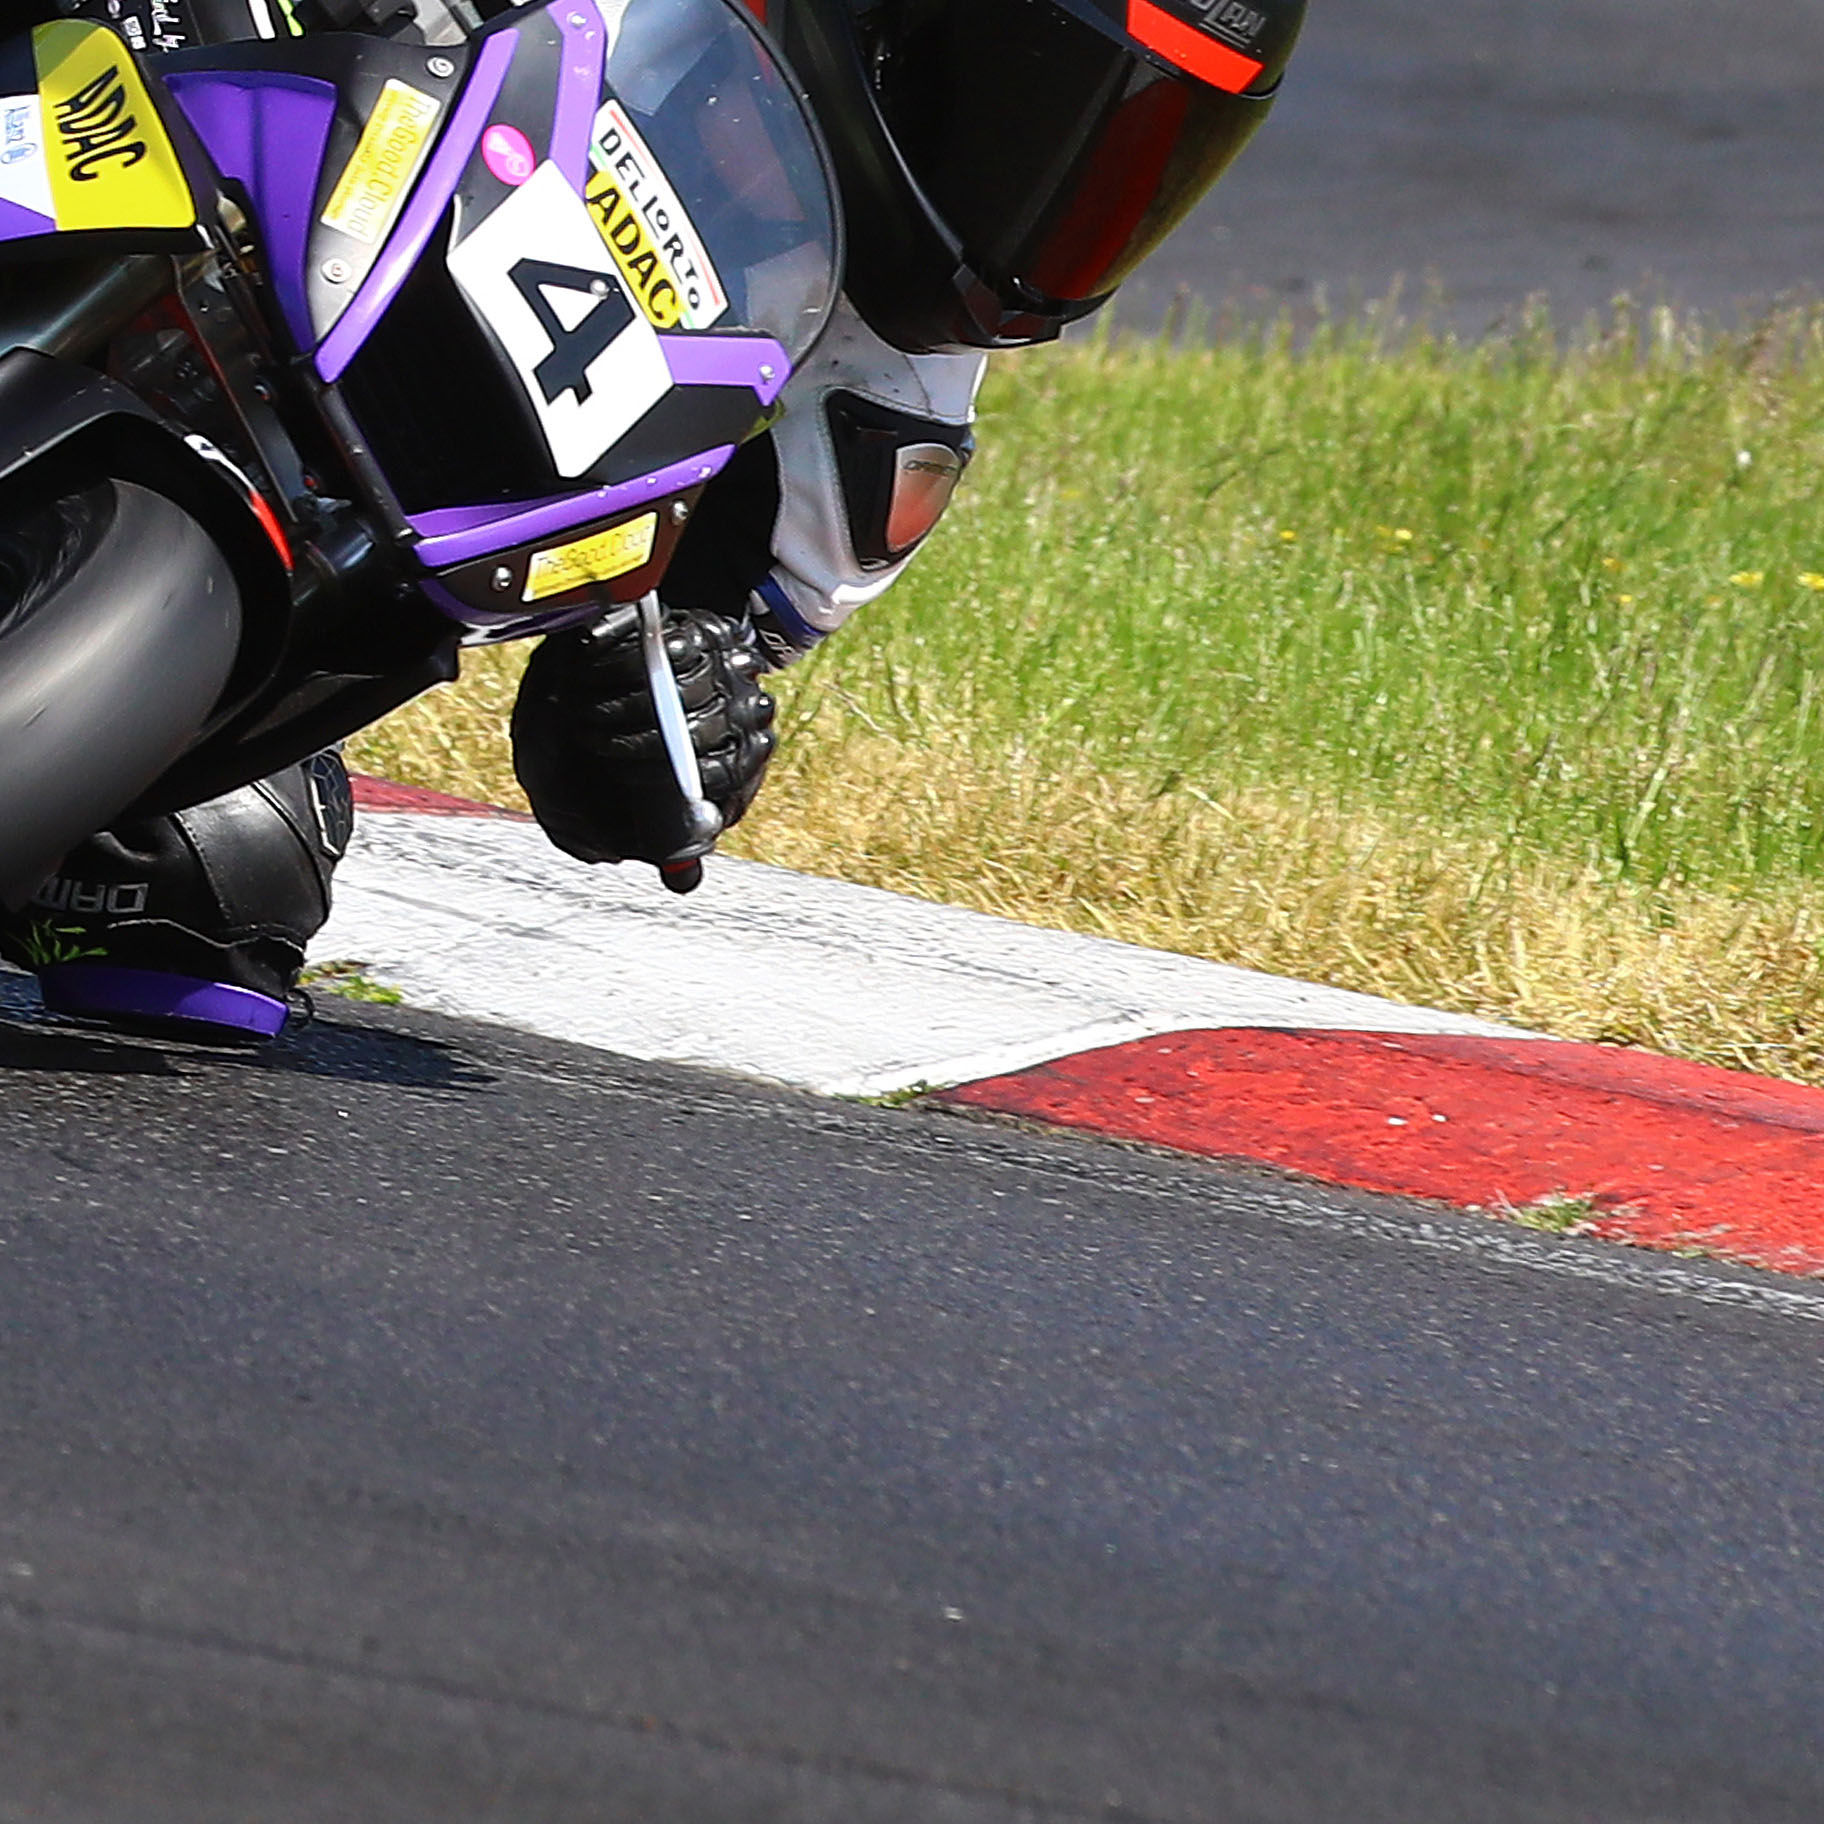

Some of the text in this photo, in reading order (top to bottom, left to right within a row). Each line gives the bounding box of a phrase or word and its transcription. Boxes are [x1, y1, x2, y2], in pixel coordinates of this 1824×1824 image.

[53, 65, 147, 183] ADAC
[587, 187, 677, 320] ADAC
[508, 257, 634, 405] 4
